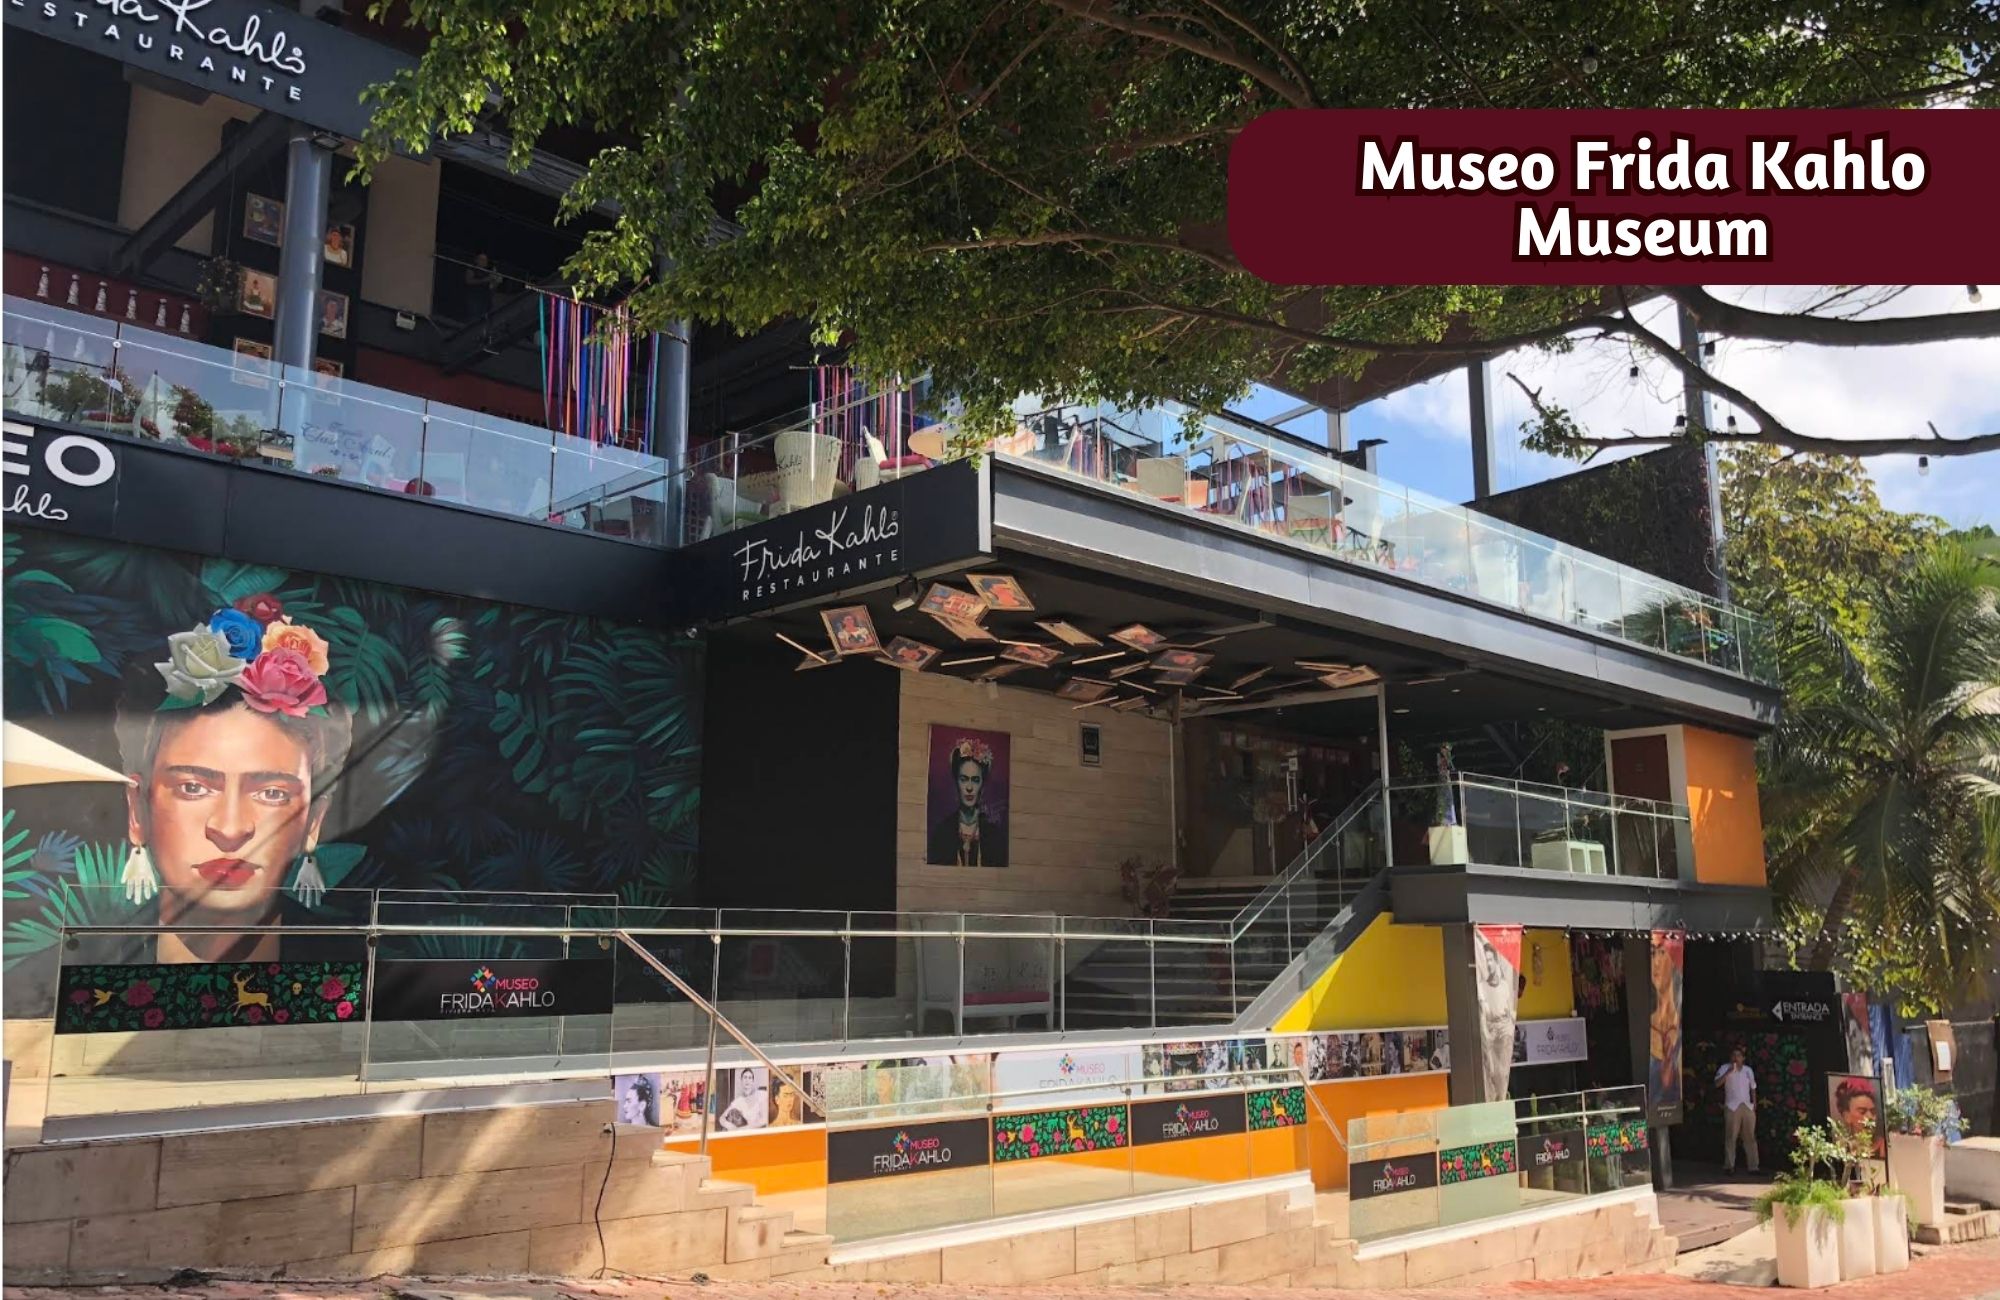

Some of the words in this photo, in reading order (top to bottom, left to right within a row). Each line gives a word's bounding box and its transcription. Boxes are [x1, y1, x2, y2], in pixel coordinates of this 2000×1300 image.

[733, 530, 822, 582] Frida
[814, 503, 899, 556] Kahlo
[742, 549, 899, 600] RESTAURANTE
[495, 978, 539, 990] MUSEO
[1782, 1001, 1830, 1015] ENTRADA
[1076, 1063, 1105, 1075] MUSEO
[910, 1137, 940, 1150] MUSEO
